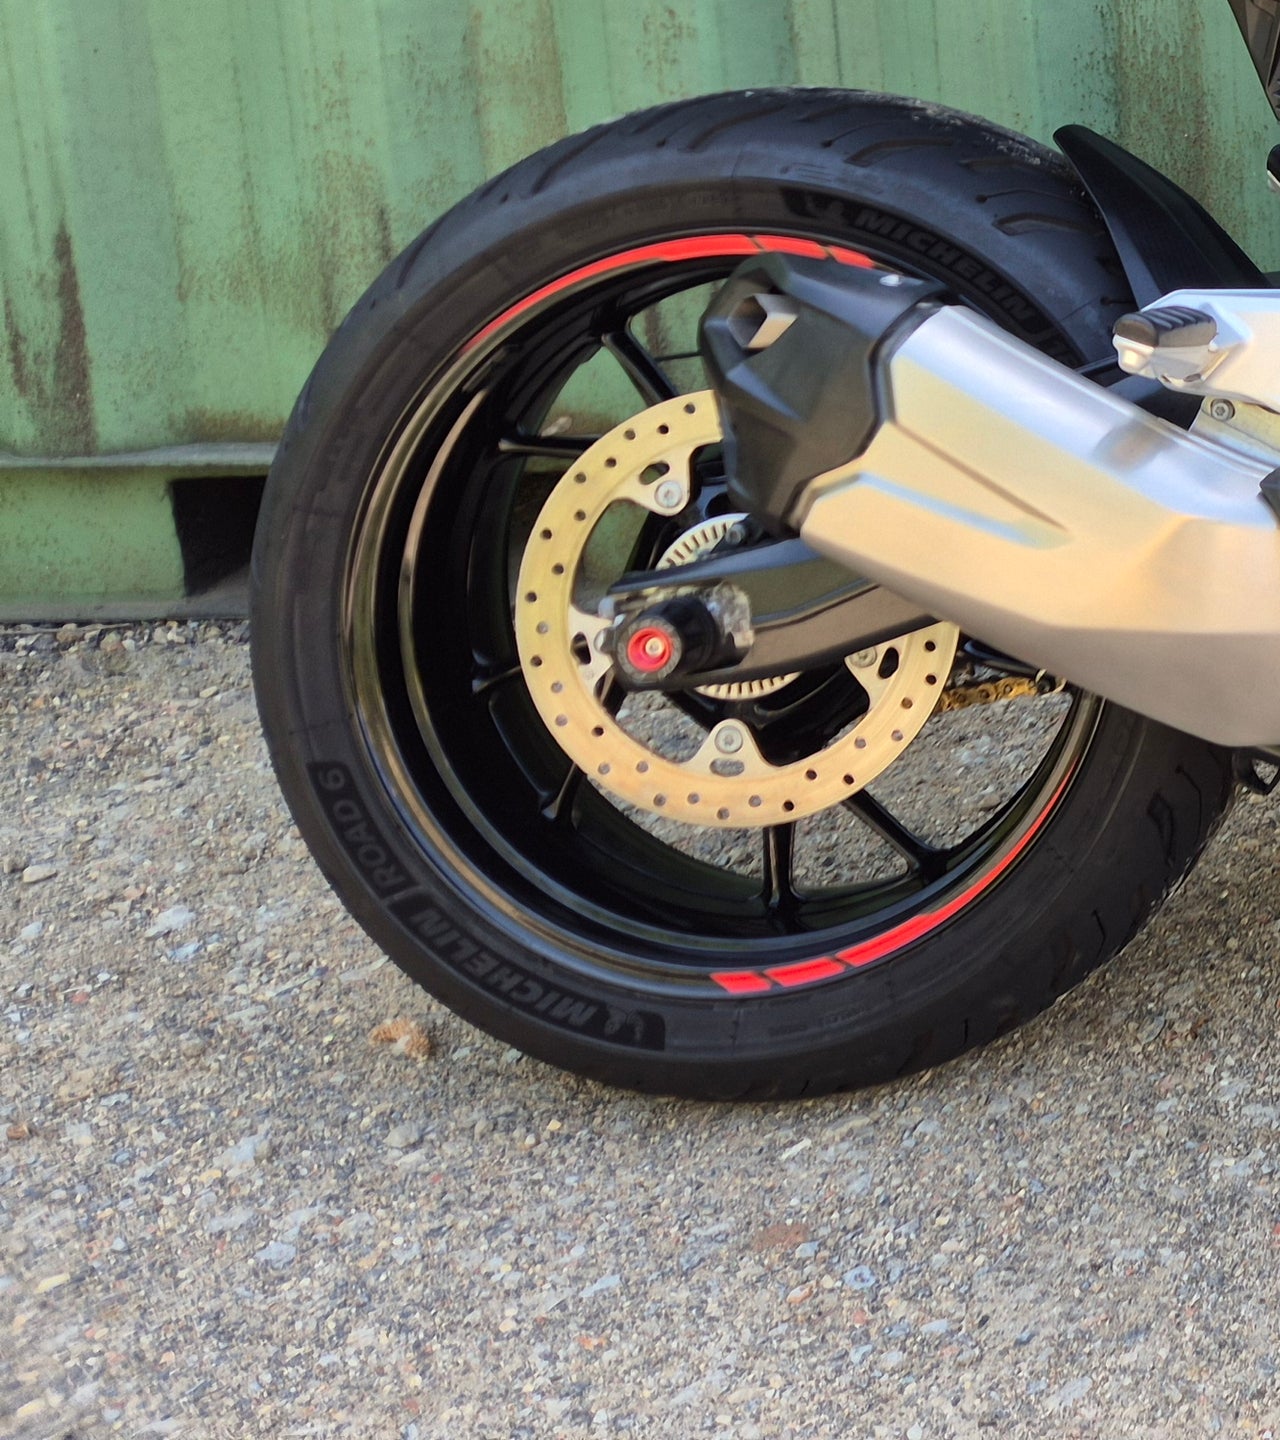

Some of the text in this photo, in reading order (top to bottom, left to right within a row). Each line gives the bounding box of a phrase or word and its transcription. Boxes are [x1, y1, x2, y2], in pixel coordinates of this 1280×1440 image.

[853, 212, 1039, 328] MICHELIN
[317, 767, 598, 1027] MICHELIN ROAD 6
